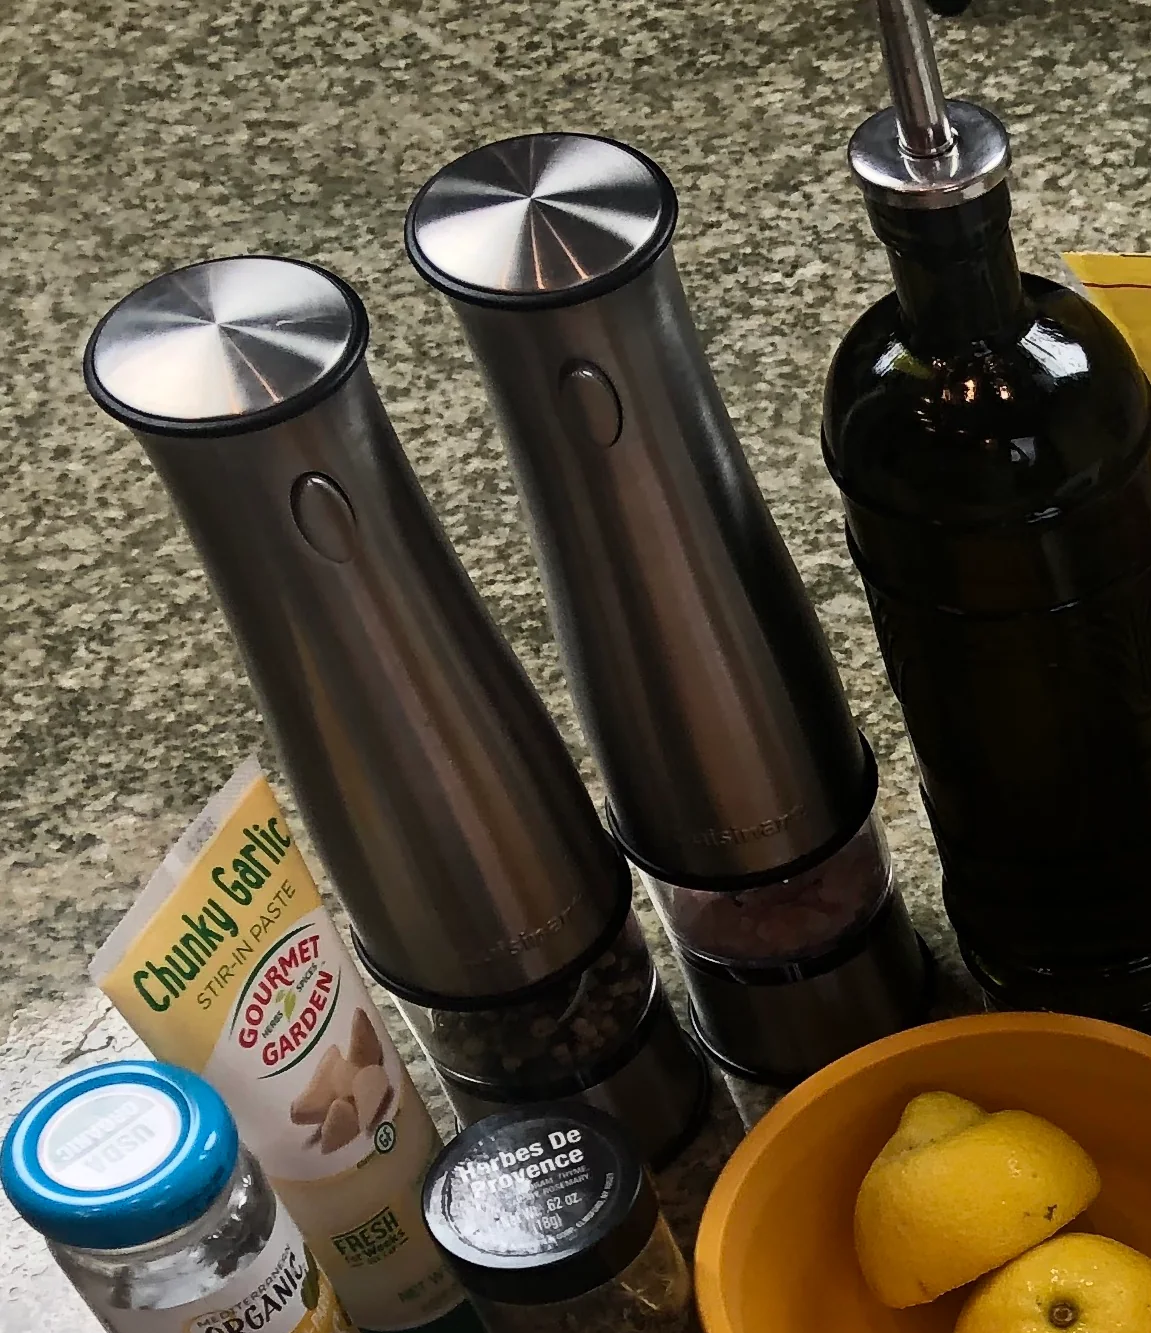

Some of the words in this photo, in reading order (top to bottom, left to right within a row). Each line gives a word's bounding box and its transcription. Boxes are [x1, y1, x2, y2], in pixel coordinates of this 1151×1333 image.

[133, 898, 239, 1013] Chunky
[211, 817, 291, 905] Garlic
[197, 939, 254, 1010] STIR-IN
[249, 879, 296, 942] PASTE
[238, 934, 320, 1049] GOURMET
[262, 970, 334, 1066] GARDEN
[56, 1101, 139, 1161] ORGANIC
[80, 1123, 155, 1173] USDA
[454, 1141, 544, 1183] Herbes
[548, 1129, 582, 1150] De
[470, 1149, 584, 1199] Provence
[332, 1211, 400, 1256] FRESH
